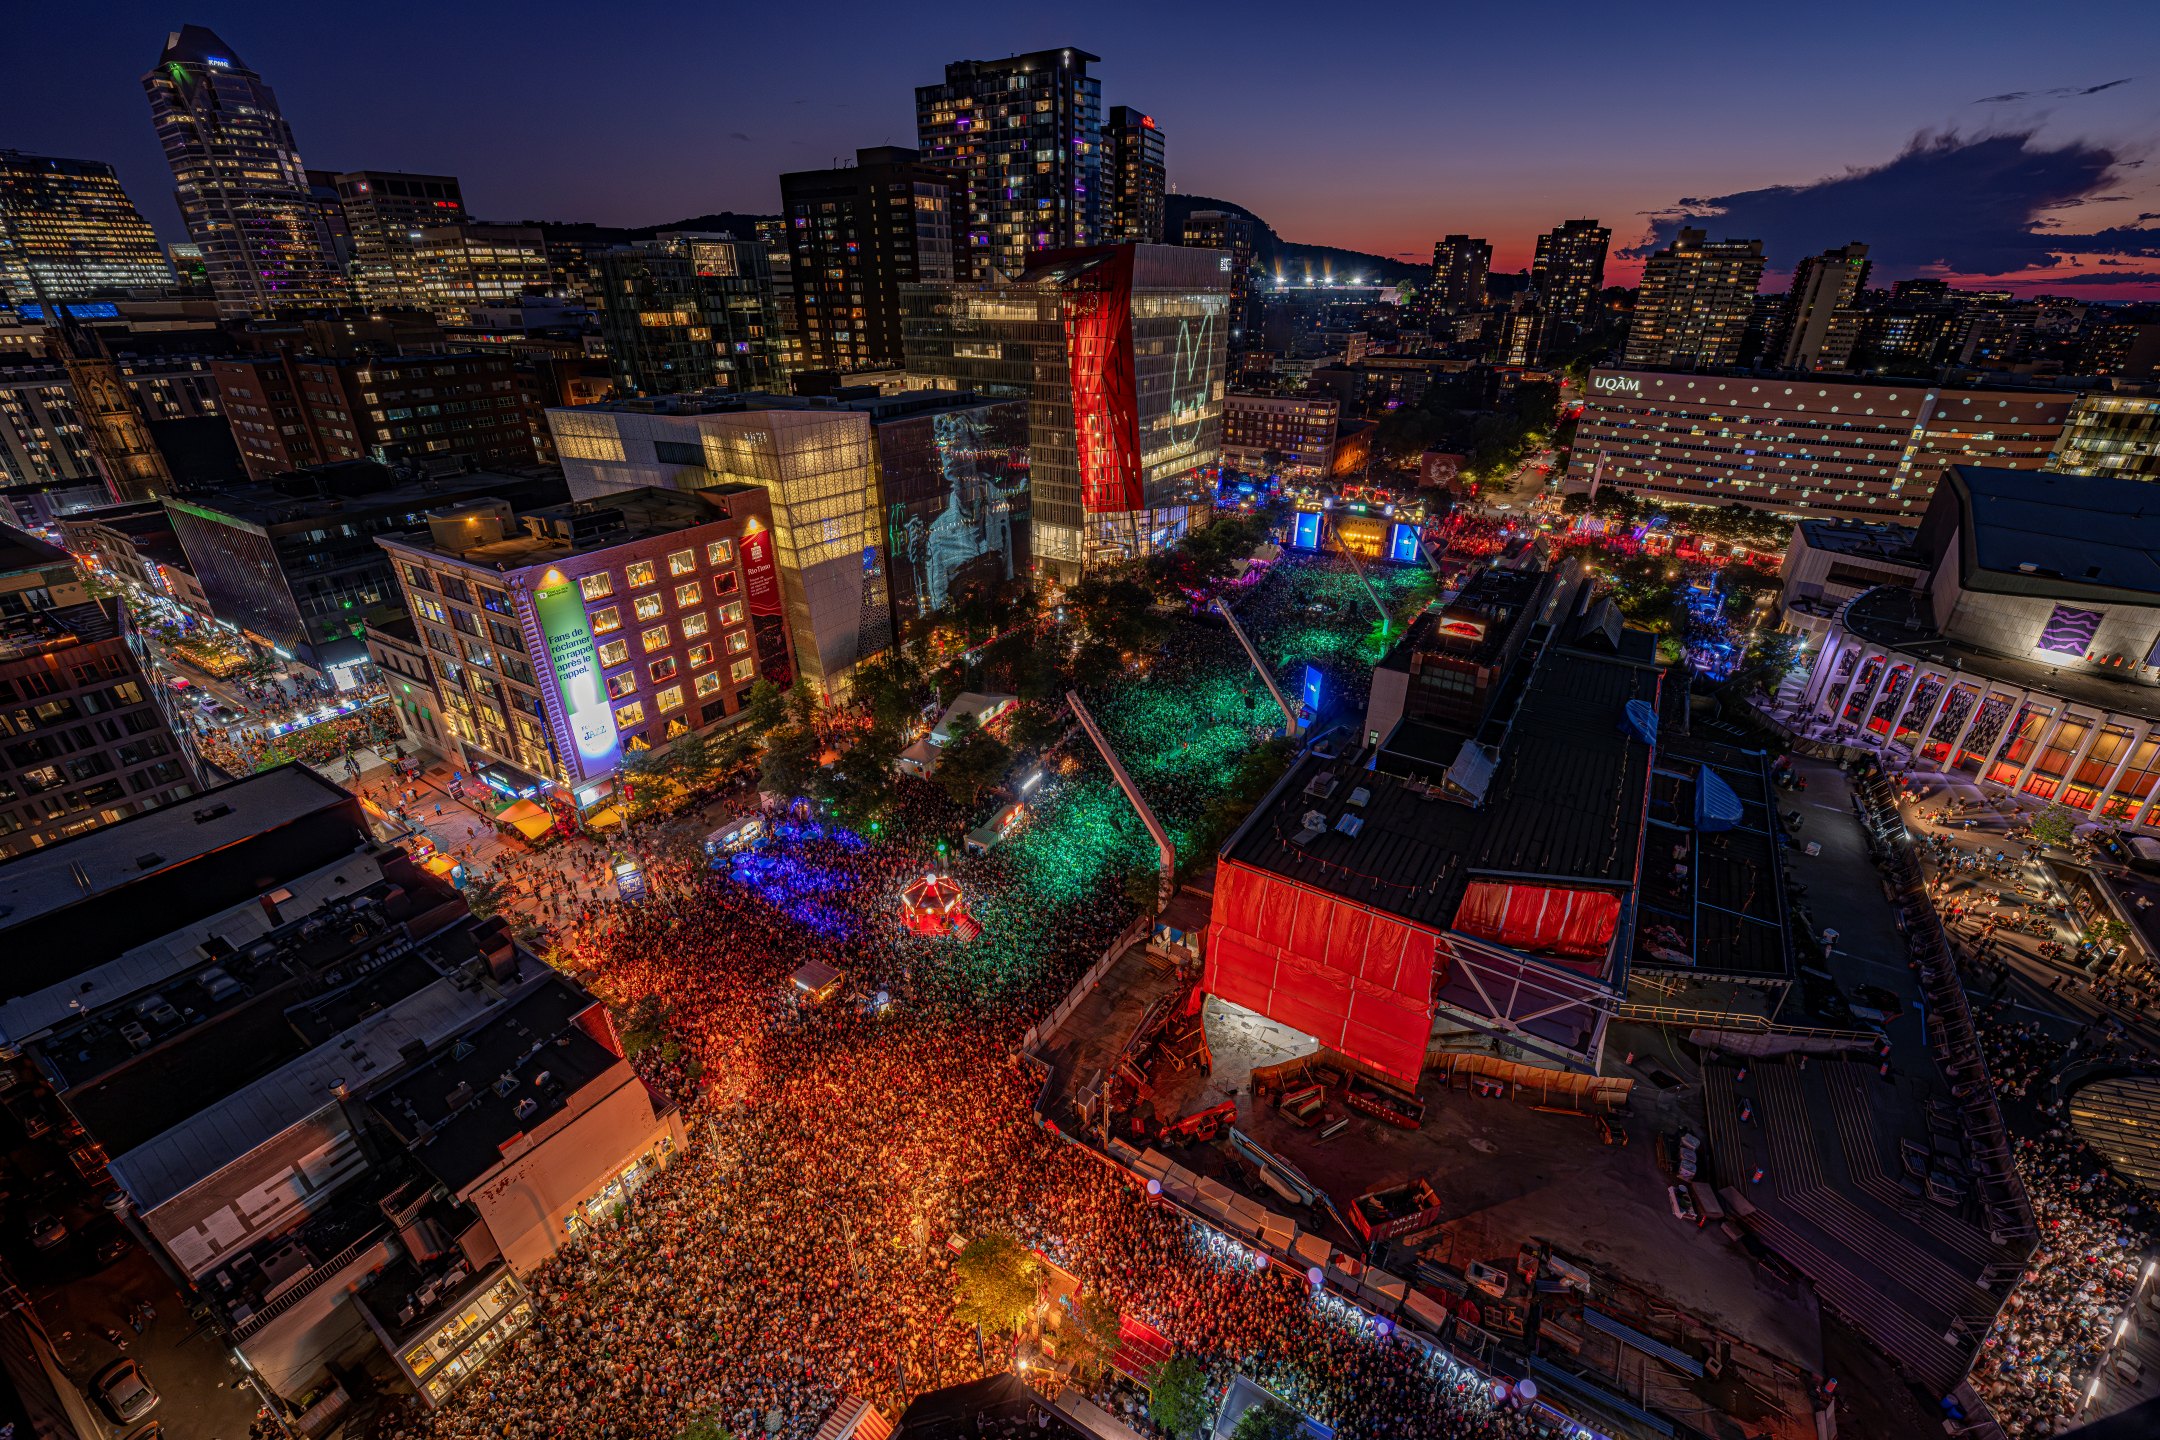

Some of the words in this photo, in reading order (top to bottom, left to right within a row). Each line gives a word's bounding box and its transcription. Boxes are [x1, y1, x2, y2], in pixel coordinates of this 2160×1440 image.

[208, 59, 229, 68] KPMG
[548, 633, 571, 645] Fans
[571, 628, 583, 637] de
[551, 636, 591, 653] réclamer
[554, 654, 565, 663] un
[566, 644, 594, 658] rappel
[557, 658, 582, 672] après
[583, 655, 591, 663] le
[559, 665, 590, 681] rappel.
